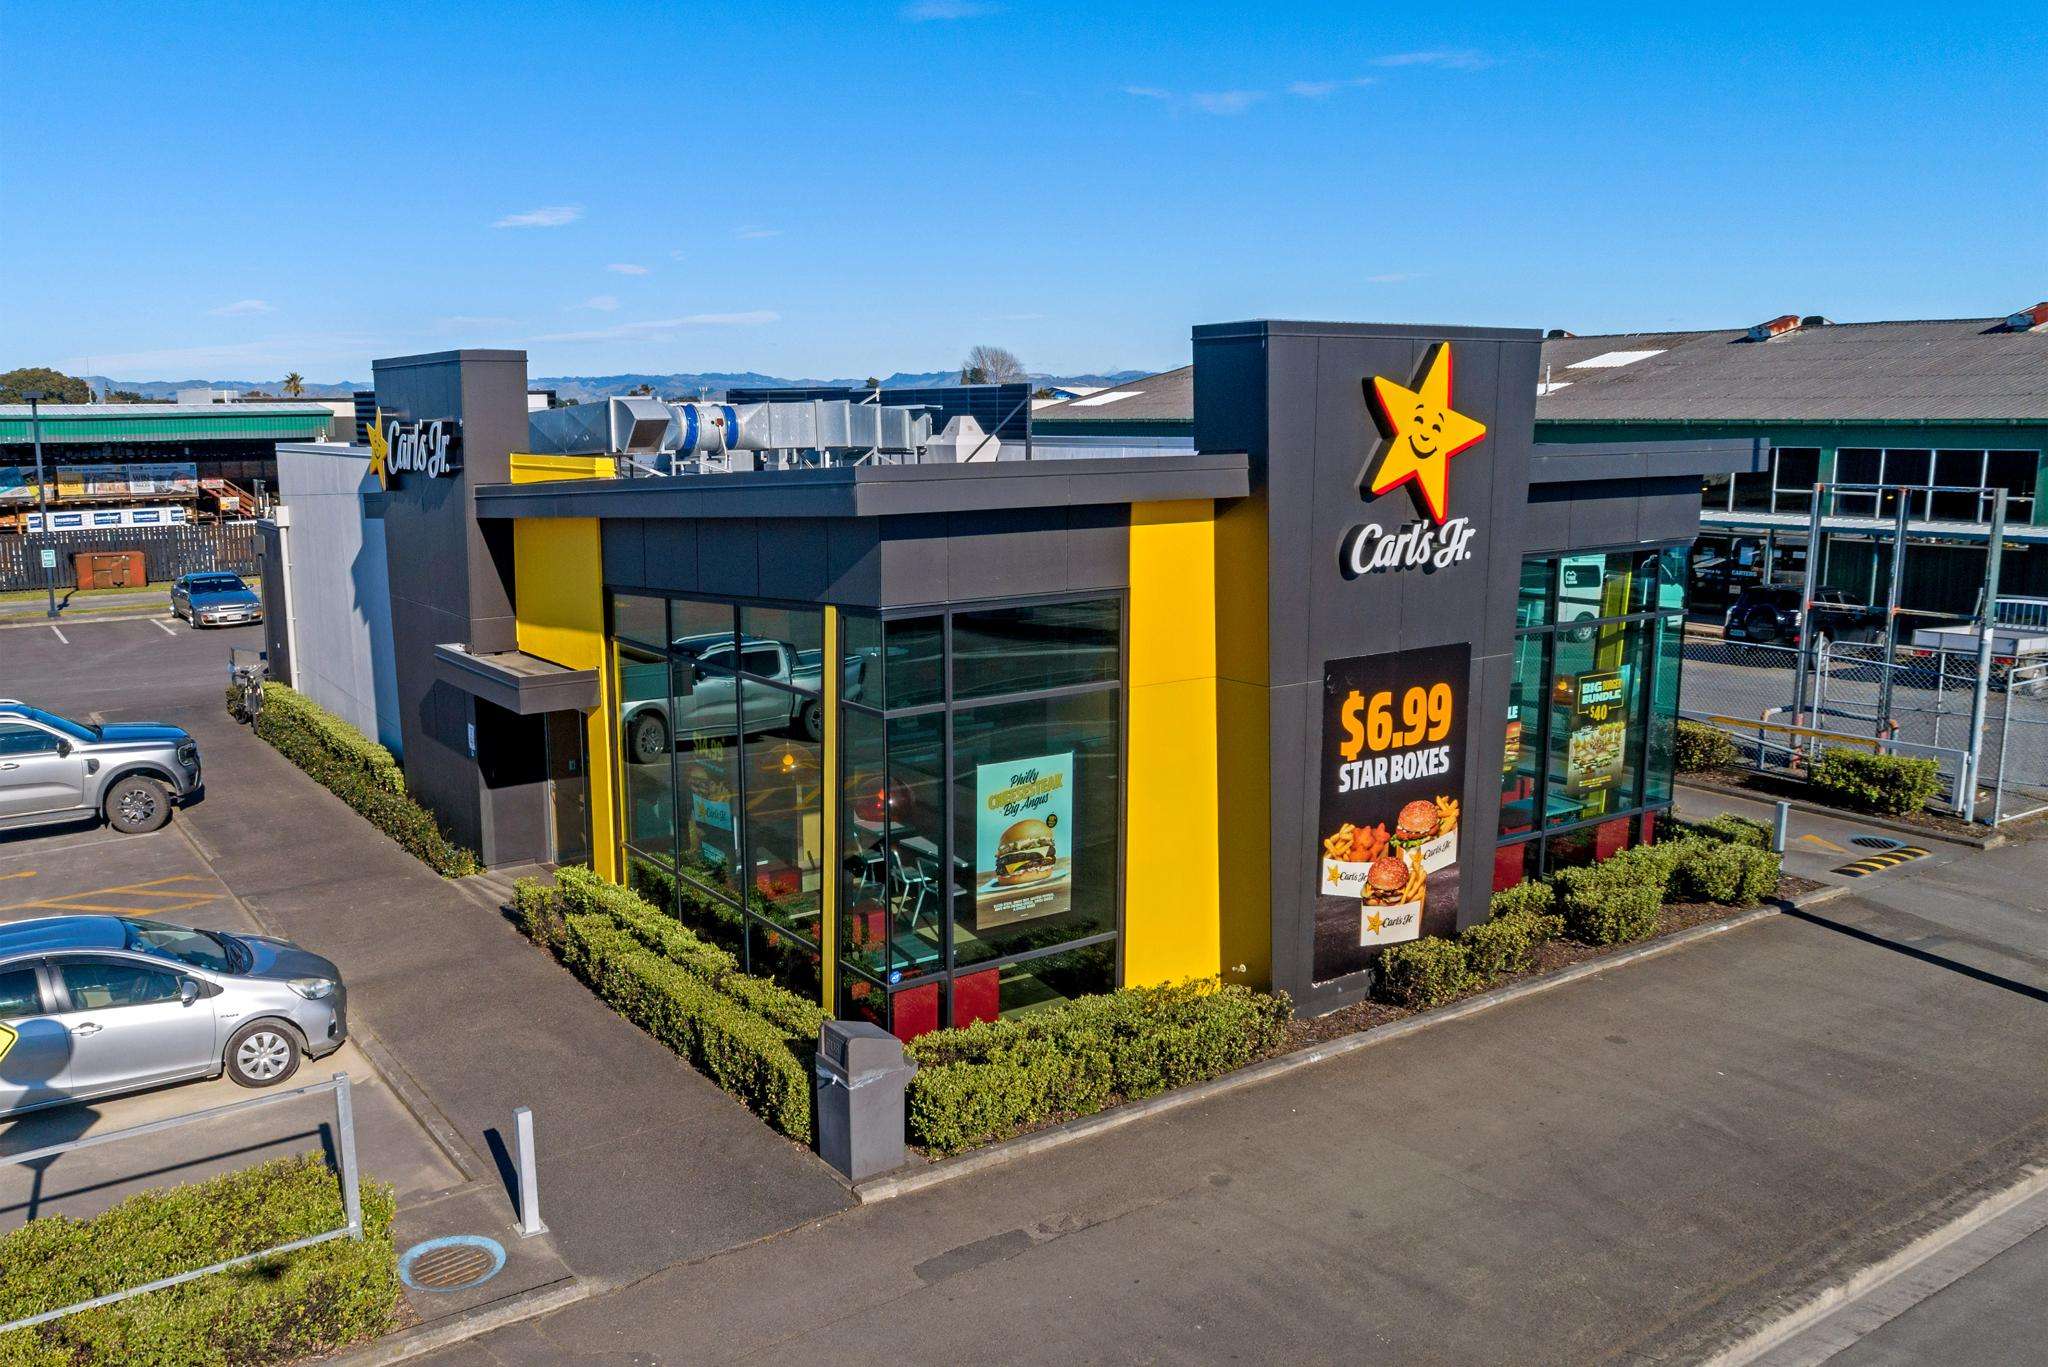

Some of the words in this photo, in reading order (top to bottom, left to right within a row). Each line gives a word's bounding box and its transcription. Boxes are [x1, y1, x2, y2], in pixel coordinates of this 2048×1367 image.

[387, 418, 427, 475] Carl's
[427, 420, 450, 479] Jr.
[1351, 519, 1435, 574] Carl's
[1433, 516, 1477, 569] Jr.
[1581, 689, 1622, 705] BUNDLE
[1582, 681, 1603, 694] BIG
[1340, 682, 1453, 762] $6.99
[1589, 703, 1608, 721] $40
[1009, 767, 1039, 788] Philly
[1338, 756, 1388, 793] STAR
[1390, 745, 1450, 784] BOXES
[1003, 801, 1020, 818] Big
[1020, 793, 1049, 811] Angus
